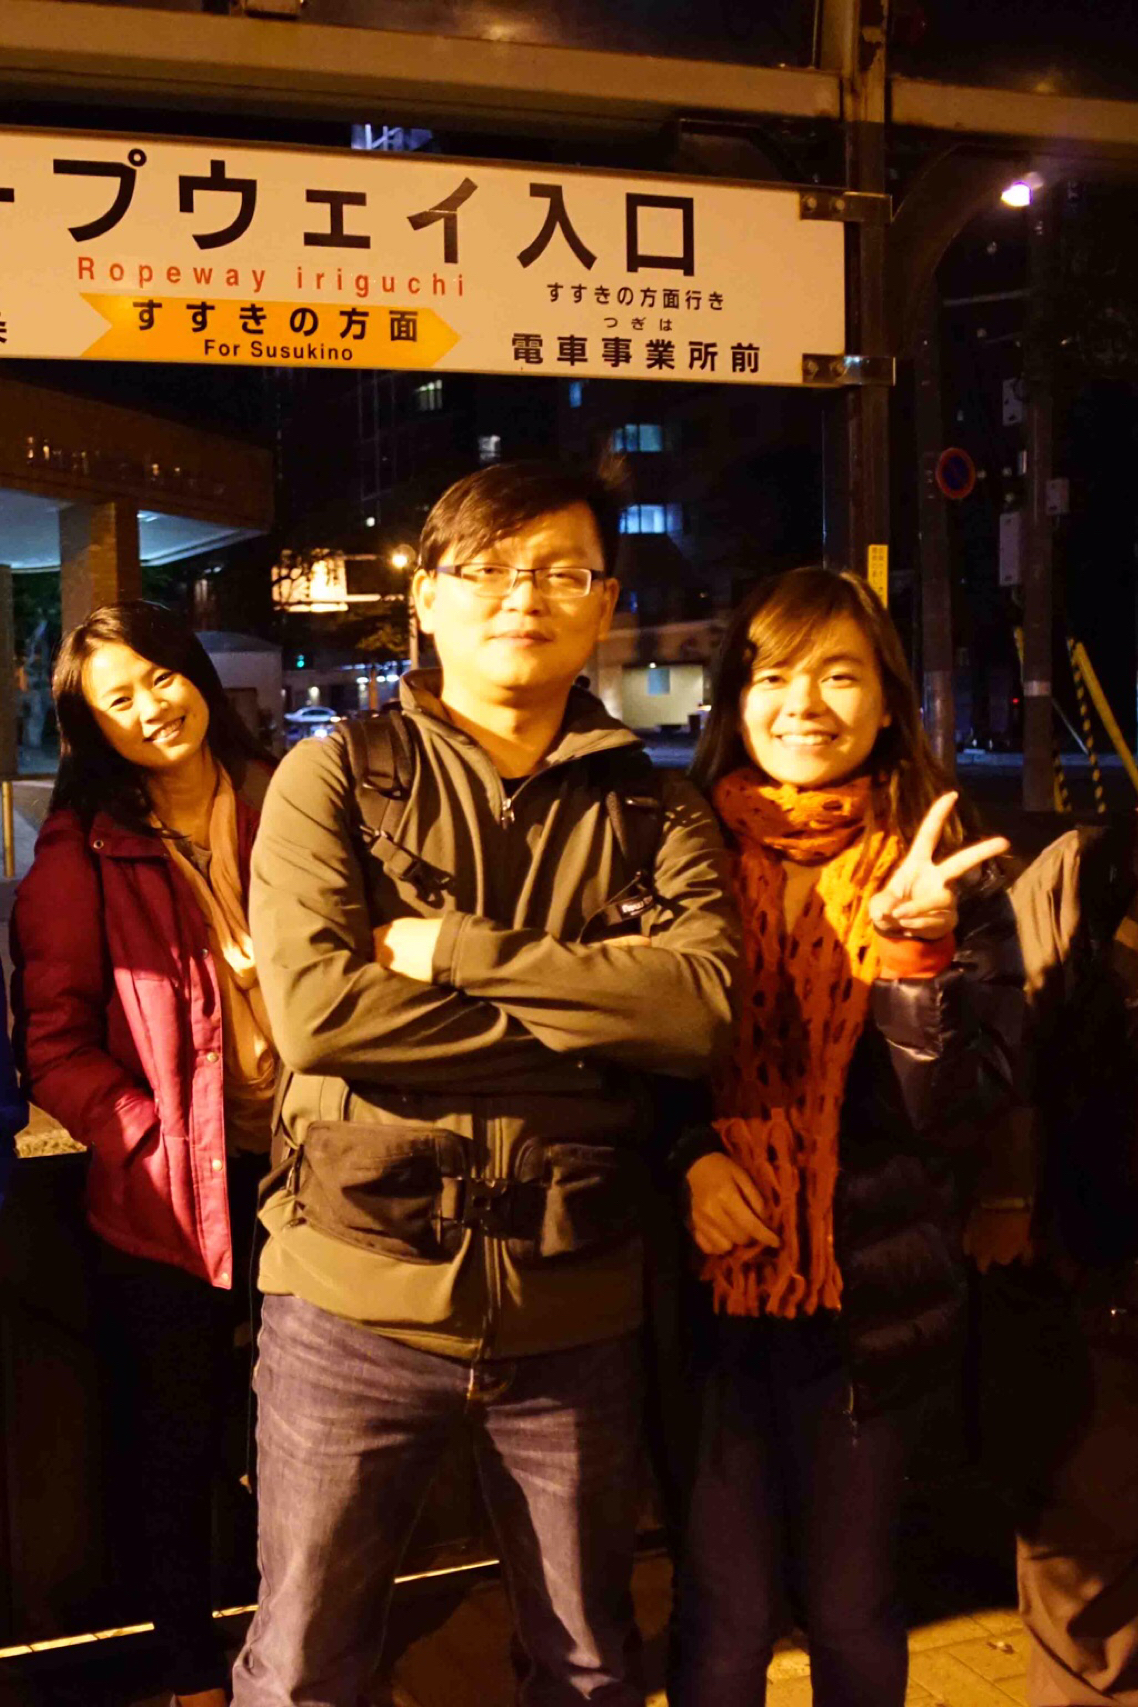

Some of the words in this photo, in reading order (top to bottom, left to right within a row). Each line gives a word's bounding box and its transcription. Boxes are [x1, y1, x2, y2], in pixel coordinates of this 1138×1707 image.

[77, 256, 266, 292] Ropeway
[296, 266, 464, 298] iriguchi
[547, 282, 724, 311] すすきの方面行き
[132, 299, 419, 343] すすきの方面
[603, 316, 673, 332] つぎは
[203, 339, 240, 357] For
[251, 340, 354, 361] Susukino
[511, 332, 761, 374] 電車事業所前
